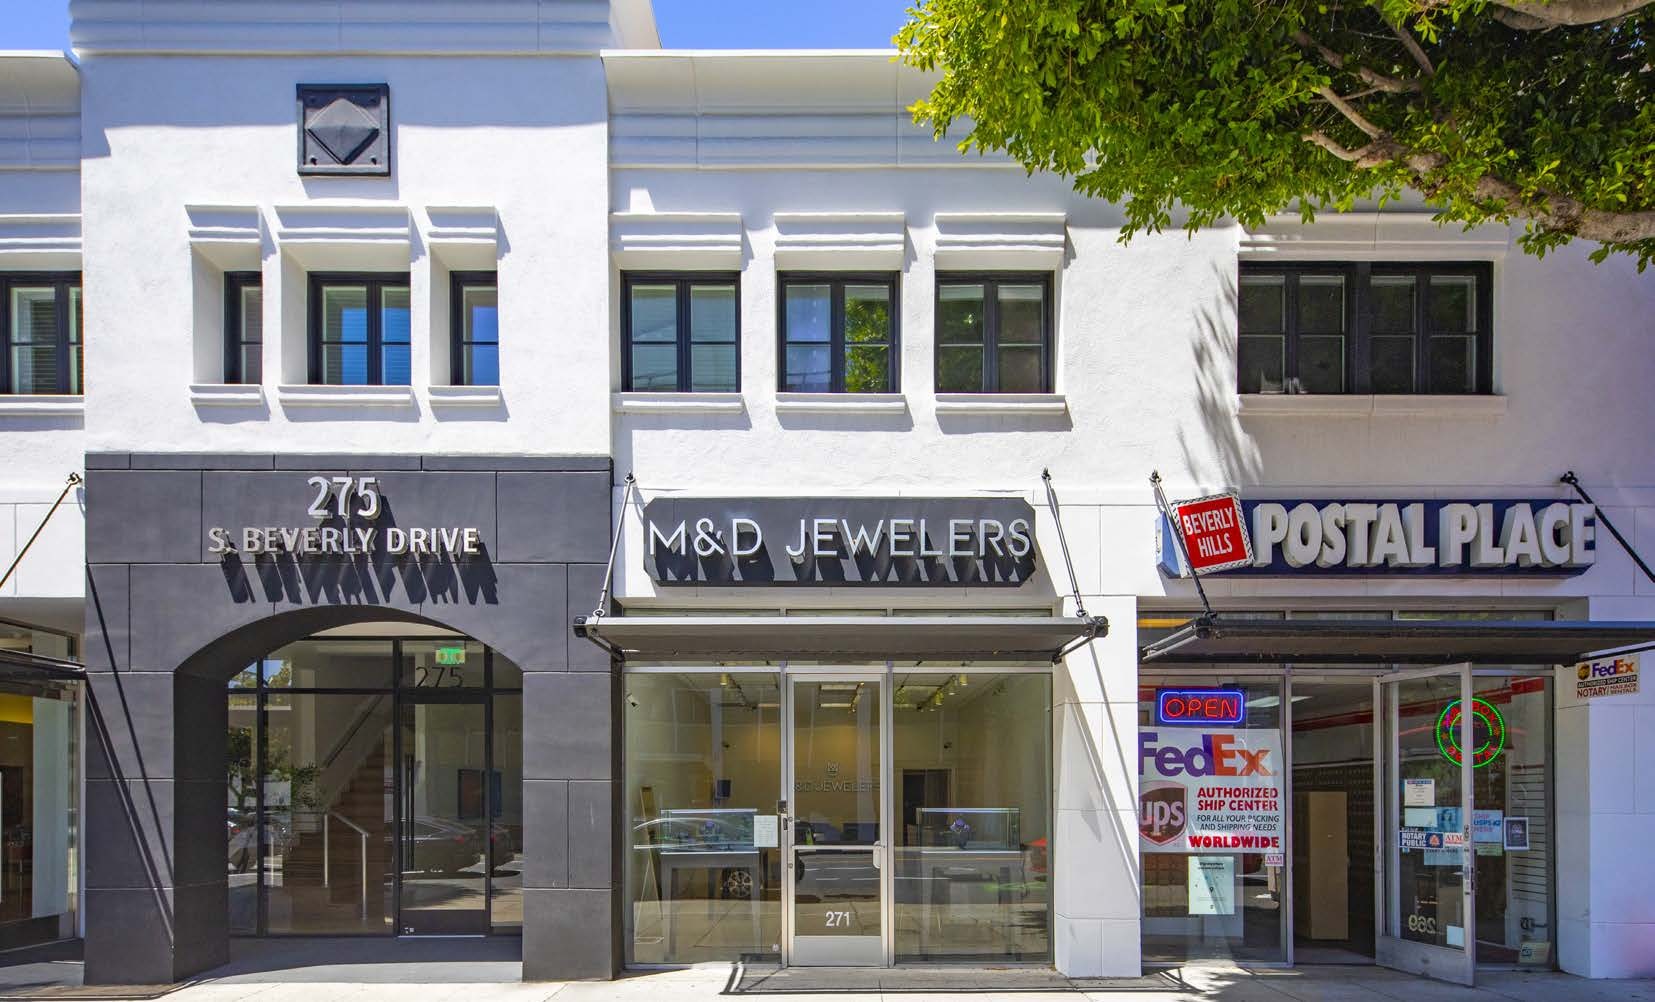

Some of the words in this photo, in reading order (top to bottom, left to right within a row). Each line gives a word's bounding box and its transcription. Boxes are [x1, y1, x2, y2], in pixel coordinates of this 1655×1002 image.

[307, 477, 379, 519] 275
[1183, 507, 1234, 535] BEVERLY
[243, 528, 377, 554] BEVERLY
[387, 528, 479, 555] DRIVE
[649, 518, 763, 557] M&D
[786, 518, 1031, 558] JEWELERS
[1253, 503, 1434, 567] POSTAL
[1439, 503, 1595, 567] PLACE
[1198, 533, 1233, 558] HILLS
[1592, 659, 1634, 677] FedEx
[1577, 686, 1607, 698] NOTARY
[1165, 698, 1238, 718] OPEN
[1139, 732, 1274, 777] FedEx
[1198, 787, 1279, 799] AUTHORIZED
[1198, 800, 1225, 811] SHIP
[1229, 800, 1279, 811] CENTER
[1140, 800, 1184, 834] ups
[1197, 814, 1211, 823] FOR
[1212, 814, 1225, 823] ALL
[1226, 814, 1247, 823] YOUR
[1200, 823, 1216, 831] AND
[1217, 823, 1252, 831] SHIPPING
[1253, 823, 1277, 831] NEEDS
[1401, 832, 1427, 840] NOTARY
[1188, 836, 1280, 849] WORLDWIDE
[825, 911, 849, 927] 271
